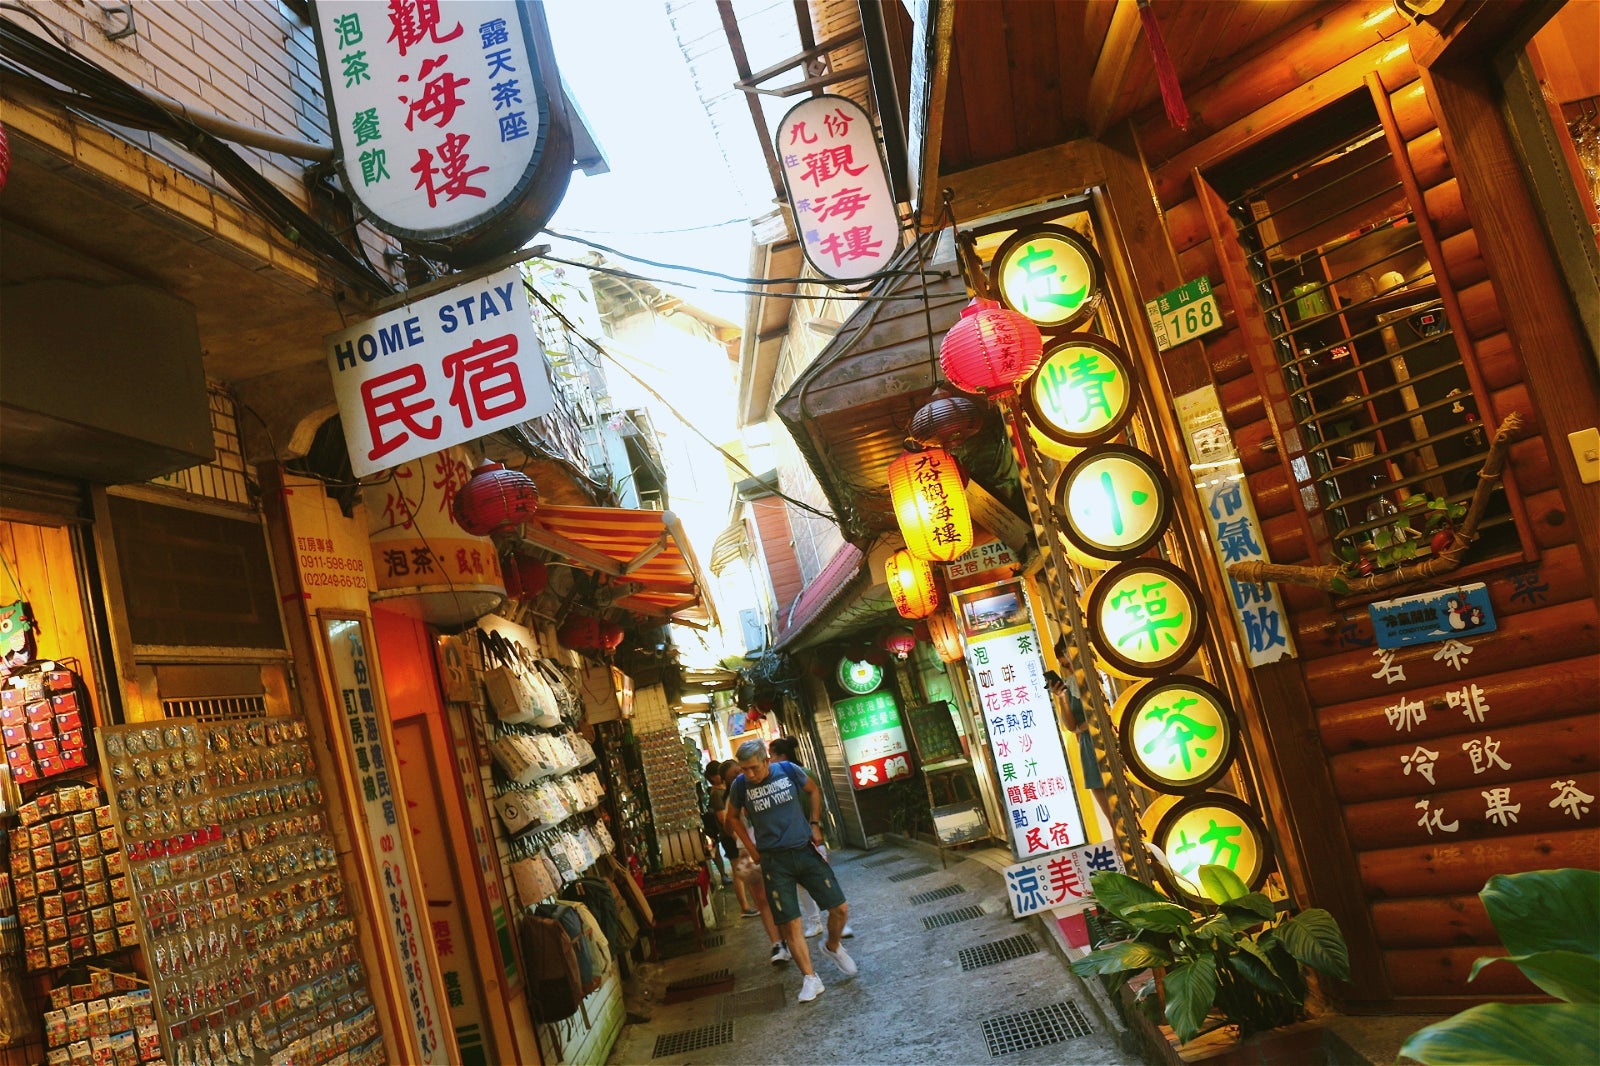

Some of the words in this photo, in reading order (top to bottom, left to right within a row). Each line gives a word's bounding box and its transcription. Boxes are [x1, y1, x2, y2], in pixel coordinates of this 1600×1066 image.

[333, 13, 371, 88] 泡茶
[352, 107, 390, 187] 餐飲
[478, 18, 529, 143] 露天茶座
[386, 0, 490, 208] 觀海樓
[790, 108, 854, 145] 九份
[800, 144, 883, 267] 觀海樓
[334, 316, 424, 372] HOME
[438, 281, 514, 334] STAY
[1171, 301, 1213, 338] 168
[360, 333, 527, 461] 民宿
[914, 455, 962, 546] 九份觀海樓
[950, 560, 978, 577] 民宿
[983, 552, 1012, 568] 休息
[979, 664, 1016, 689] 咖啡
[984, 686, 1030, 712] 花果茶
[1384, 683, 1491, 733] 咖啡
[990, 709, 1036, 736] 冷熱飲
[996, 733, 1033, 757] 冰沙
[1400, 735, 1512, 786] 冷飲
[1002, 757, 1038, 782] 果汁
[1007, 781, 1038, 806] 簡餐
[1415, 779, 1595, 836] 花果茶
[1012, 803, 1050, 829] 點心
[1026, 823, 1070, 853] 民宿
[1007, 866, 1045, 913] 涼
[1047, 856, 1082, 904] 美
